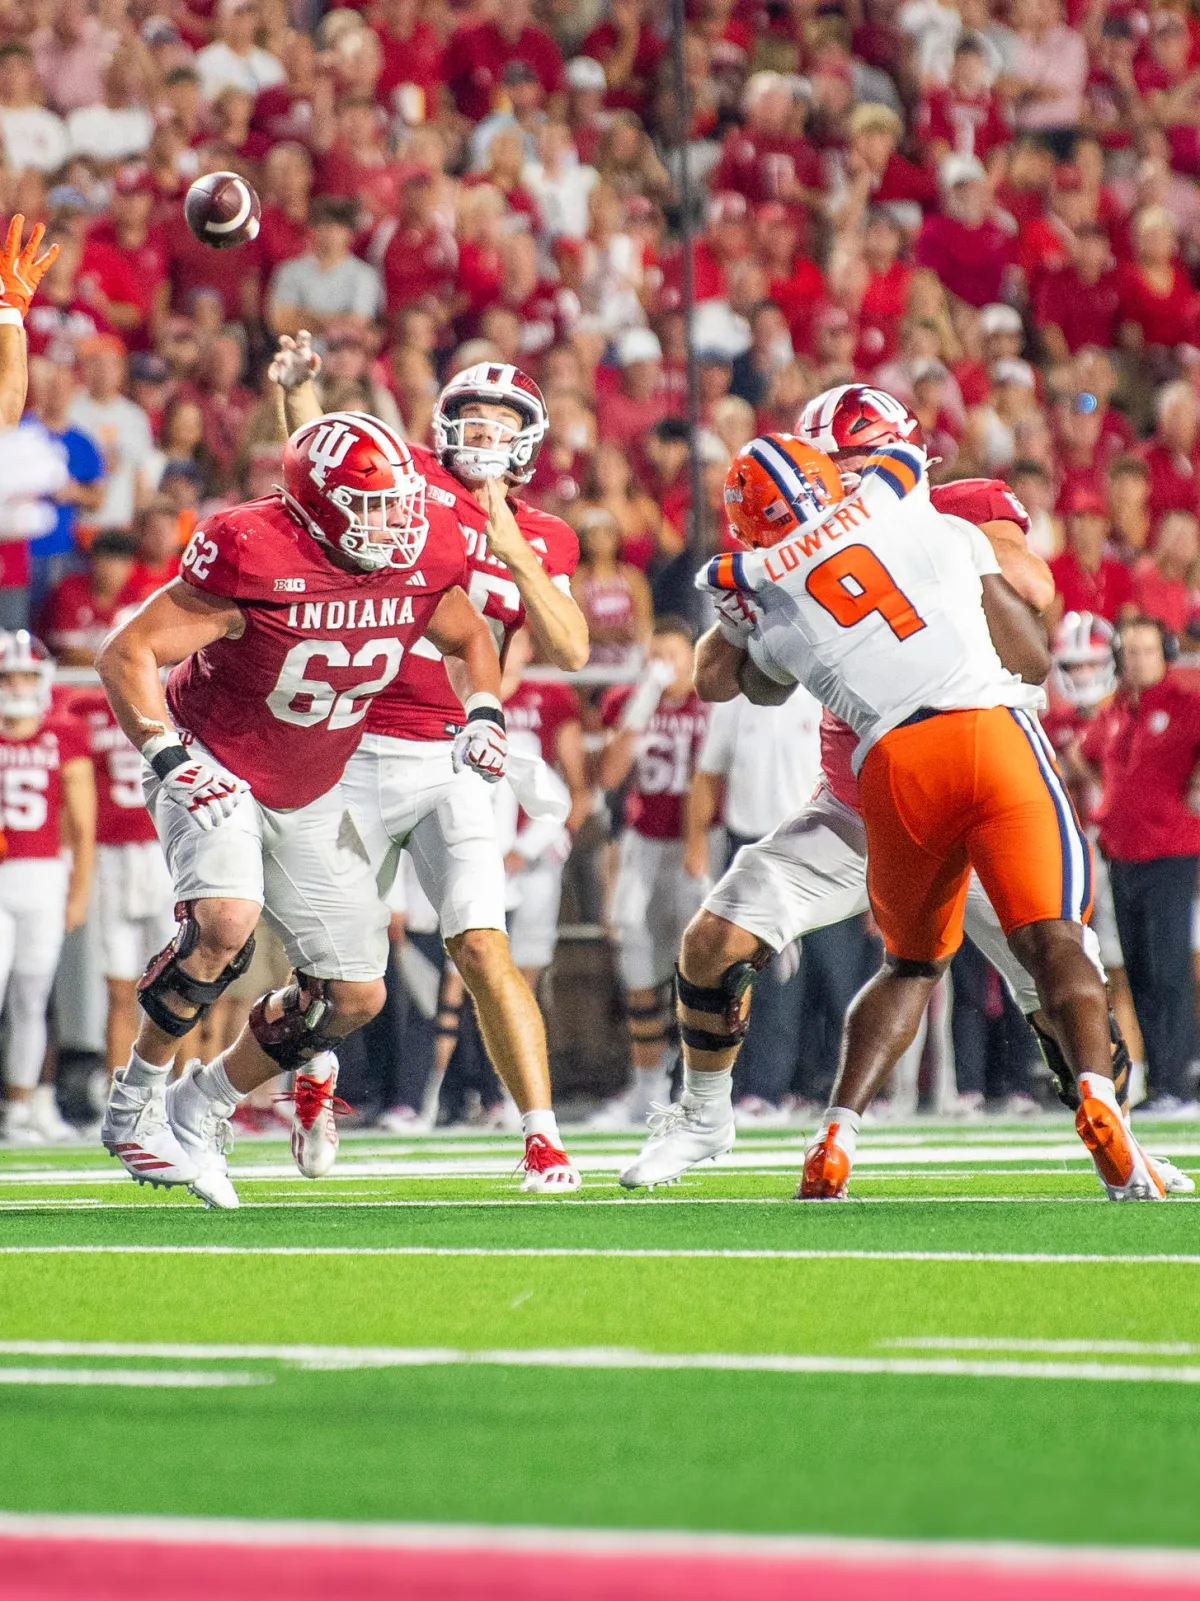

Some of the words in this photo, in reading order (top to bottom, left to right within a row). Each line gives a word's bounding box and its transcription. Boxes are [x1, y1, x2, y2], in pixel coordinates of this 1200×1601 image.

[308, 421, 359, 489] IU
[182, 531, 218, 580] 62
[763, 497, 872, 583] LOWERY
[287, 596, 415, 630] INDIANA
[805, 543, 927, 642] 9
[265, 637, 404, 731] 62
